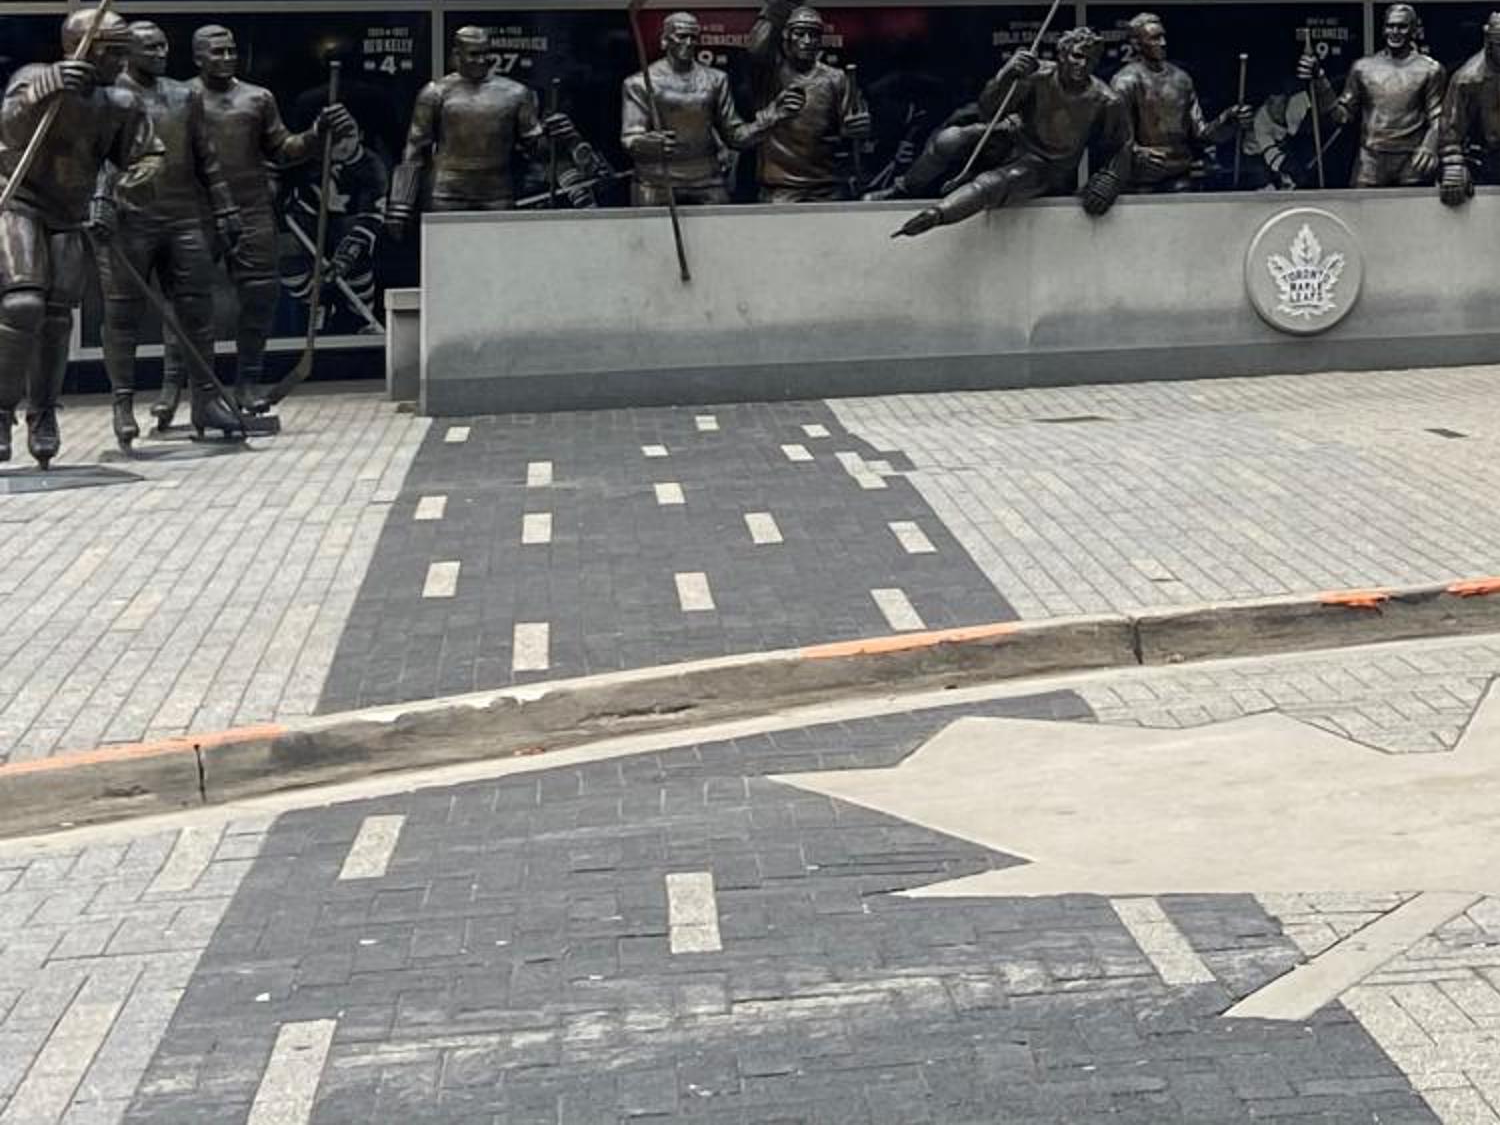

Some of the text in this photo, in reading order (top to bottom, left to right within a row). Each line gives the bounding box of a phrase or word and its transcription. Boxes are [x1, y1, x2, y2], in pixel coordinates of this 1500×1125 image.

[1316, 41, 1329, 60] 9
[379, 55, 398, 75] 4
[485, 52, 519, 75] 27
[1282, 268, 1331, 283] TORONTO
[1290, 281, 1323, 292] MAPLE
[1290, 291, 1323, 304] LEAFS
